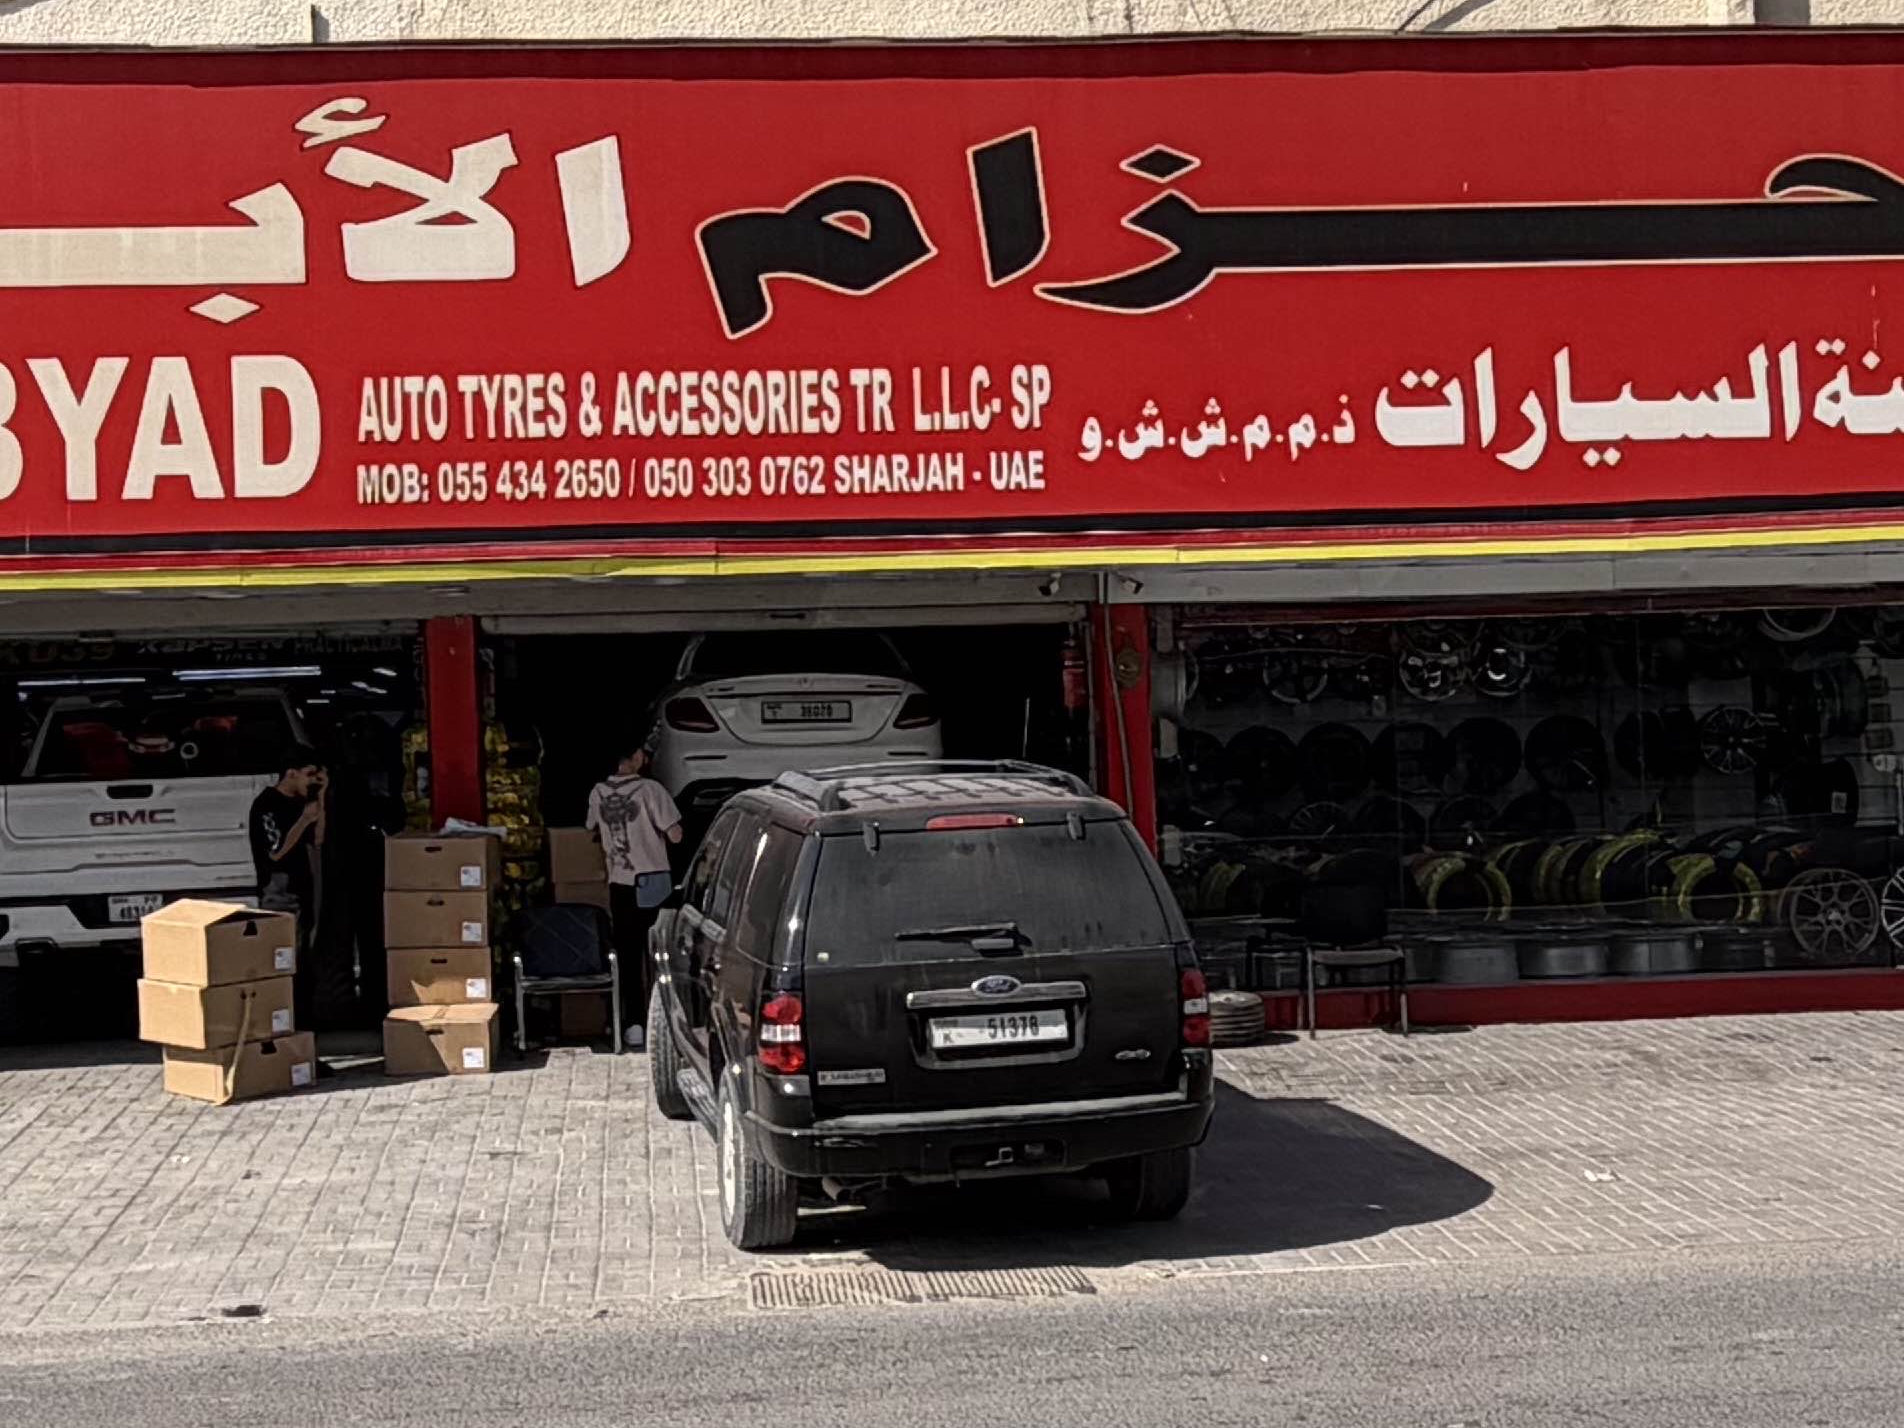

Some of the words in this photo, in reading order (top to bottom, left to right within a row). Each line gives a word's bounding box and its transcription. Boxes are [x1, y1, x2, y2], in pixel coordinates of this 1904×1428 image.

[358, 375, 448, 442] AUTO
[457, 372, 568, 439] TYRES
[578, 371, 602, 437] &
[612, 369, 841, 436] ACCESSORIES
[849, 368, 895, 432] TR
[1011, 364, 1051, 429] SP
[1375, 340, 1800, 471] السيارات
[357, 464, 430, 504] MOB:
[438, 461, 487, 503] 055
[496, 460, 546, 501] 434
[554, 458, 621, 499] 2650
[628, 457, 636, 498] /
[645, 458, 693, 498] 050
[702, 456, 752, 497] 303
[760, 455, 826, 496] 0762
[834, 452, 965, 494] SHARJAH
[989, 450, 1046, 491] UAE
[90, 808, 176, 827] GMC
